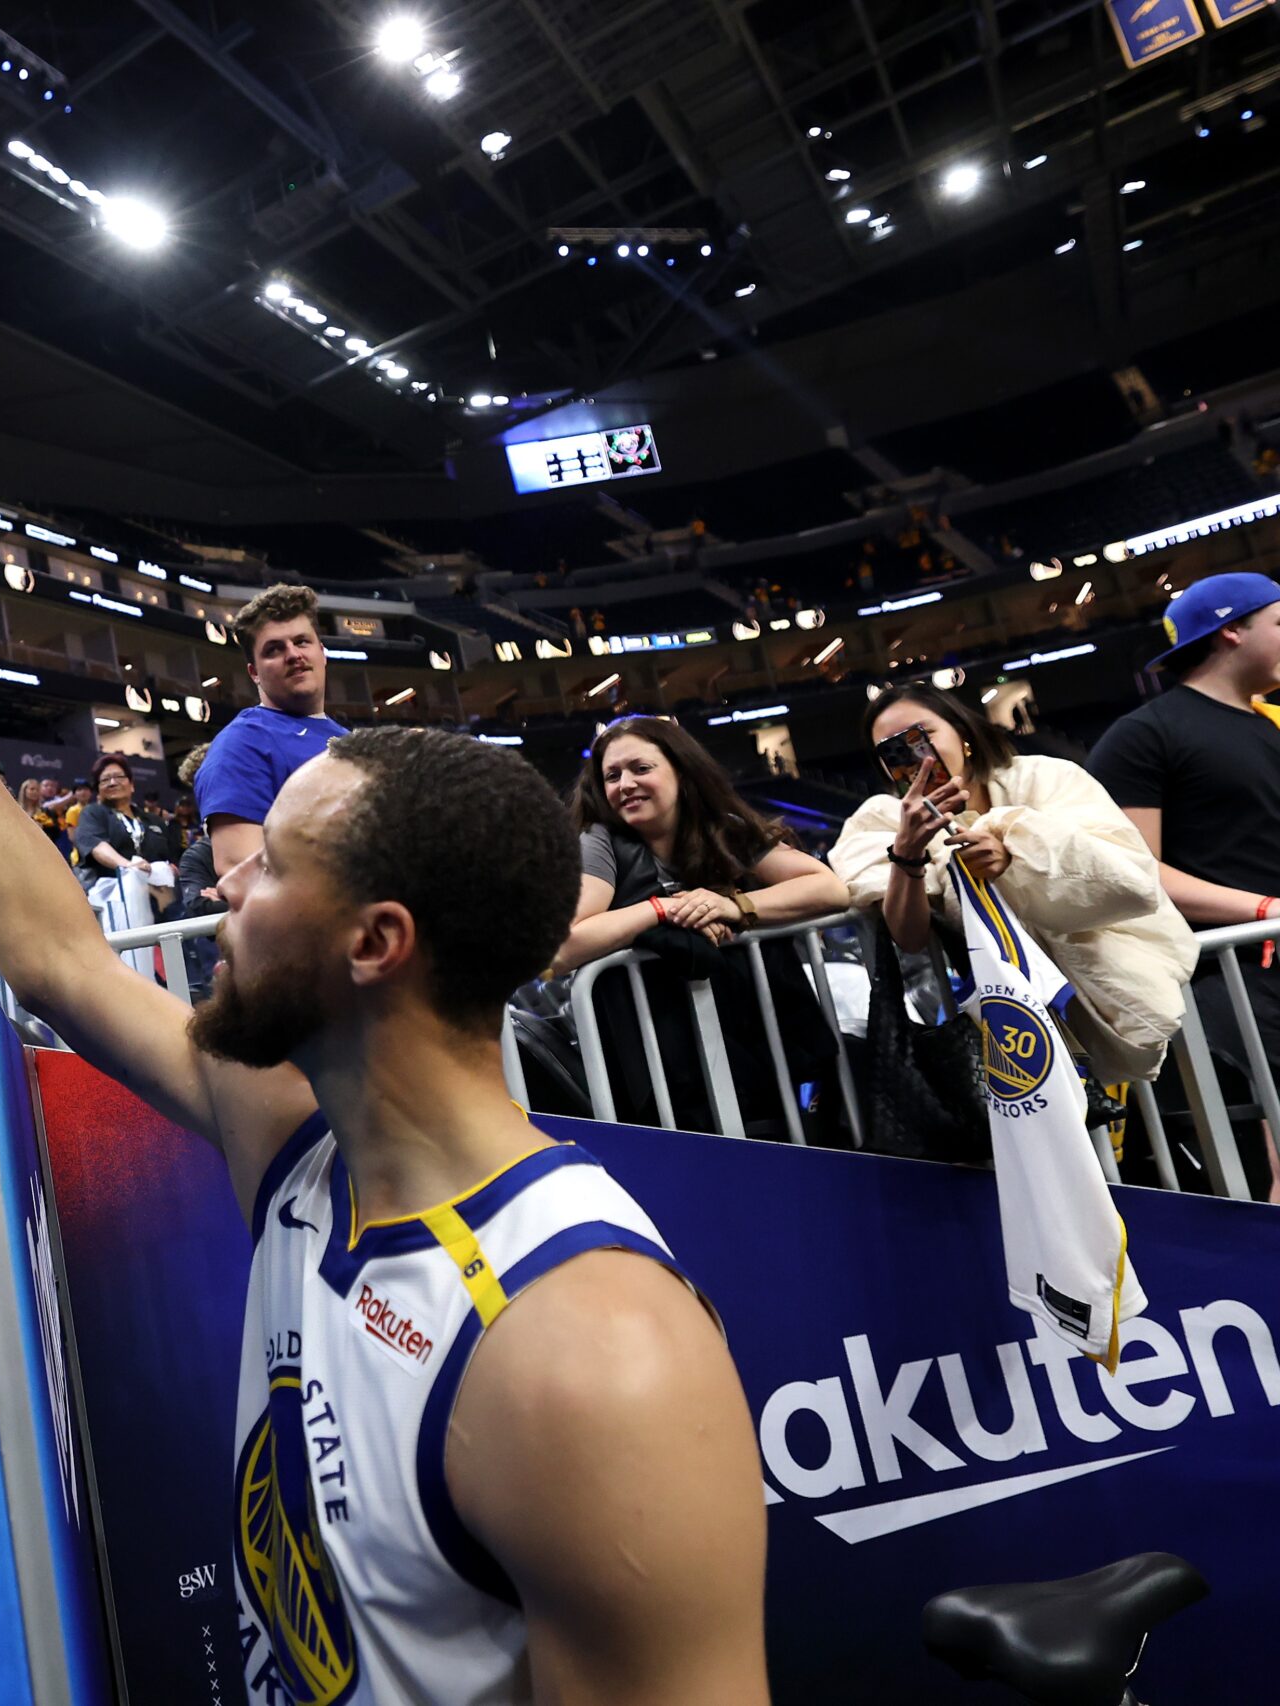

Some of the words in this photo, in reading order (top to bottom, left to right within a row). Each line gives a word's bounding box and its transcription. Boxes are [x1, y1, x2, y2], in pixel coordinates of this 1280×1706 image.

[1000, 1025, 1037, 1059] 30
[464, 1253, 484, 1279] 6
[355, 1284, 433, 1365] Rakuten
[760, 1299, 1280, 1505] akuten
[302, 1378, 350, 1525] STATE
